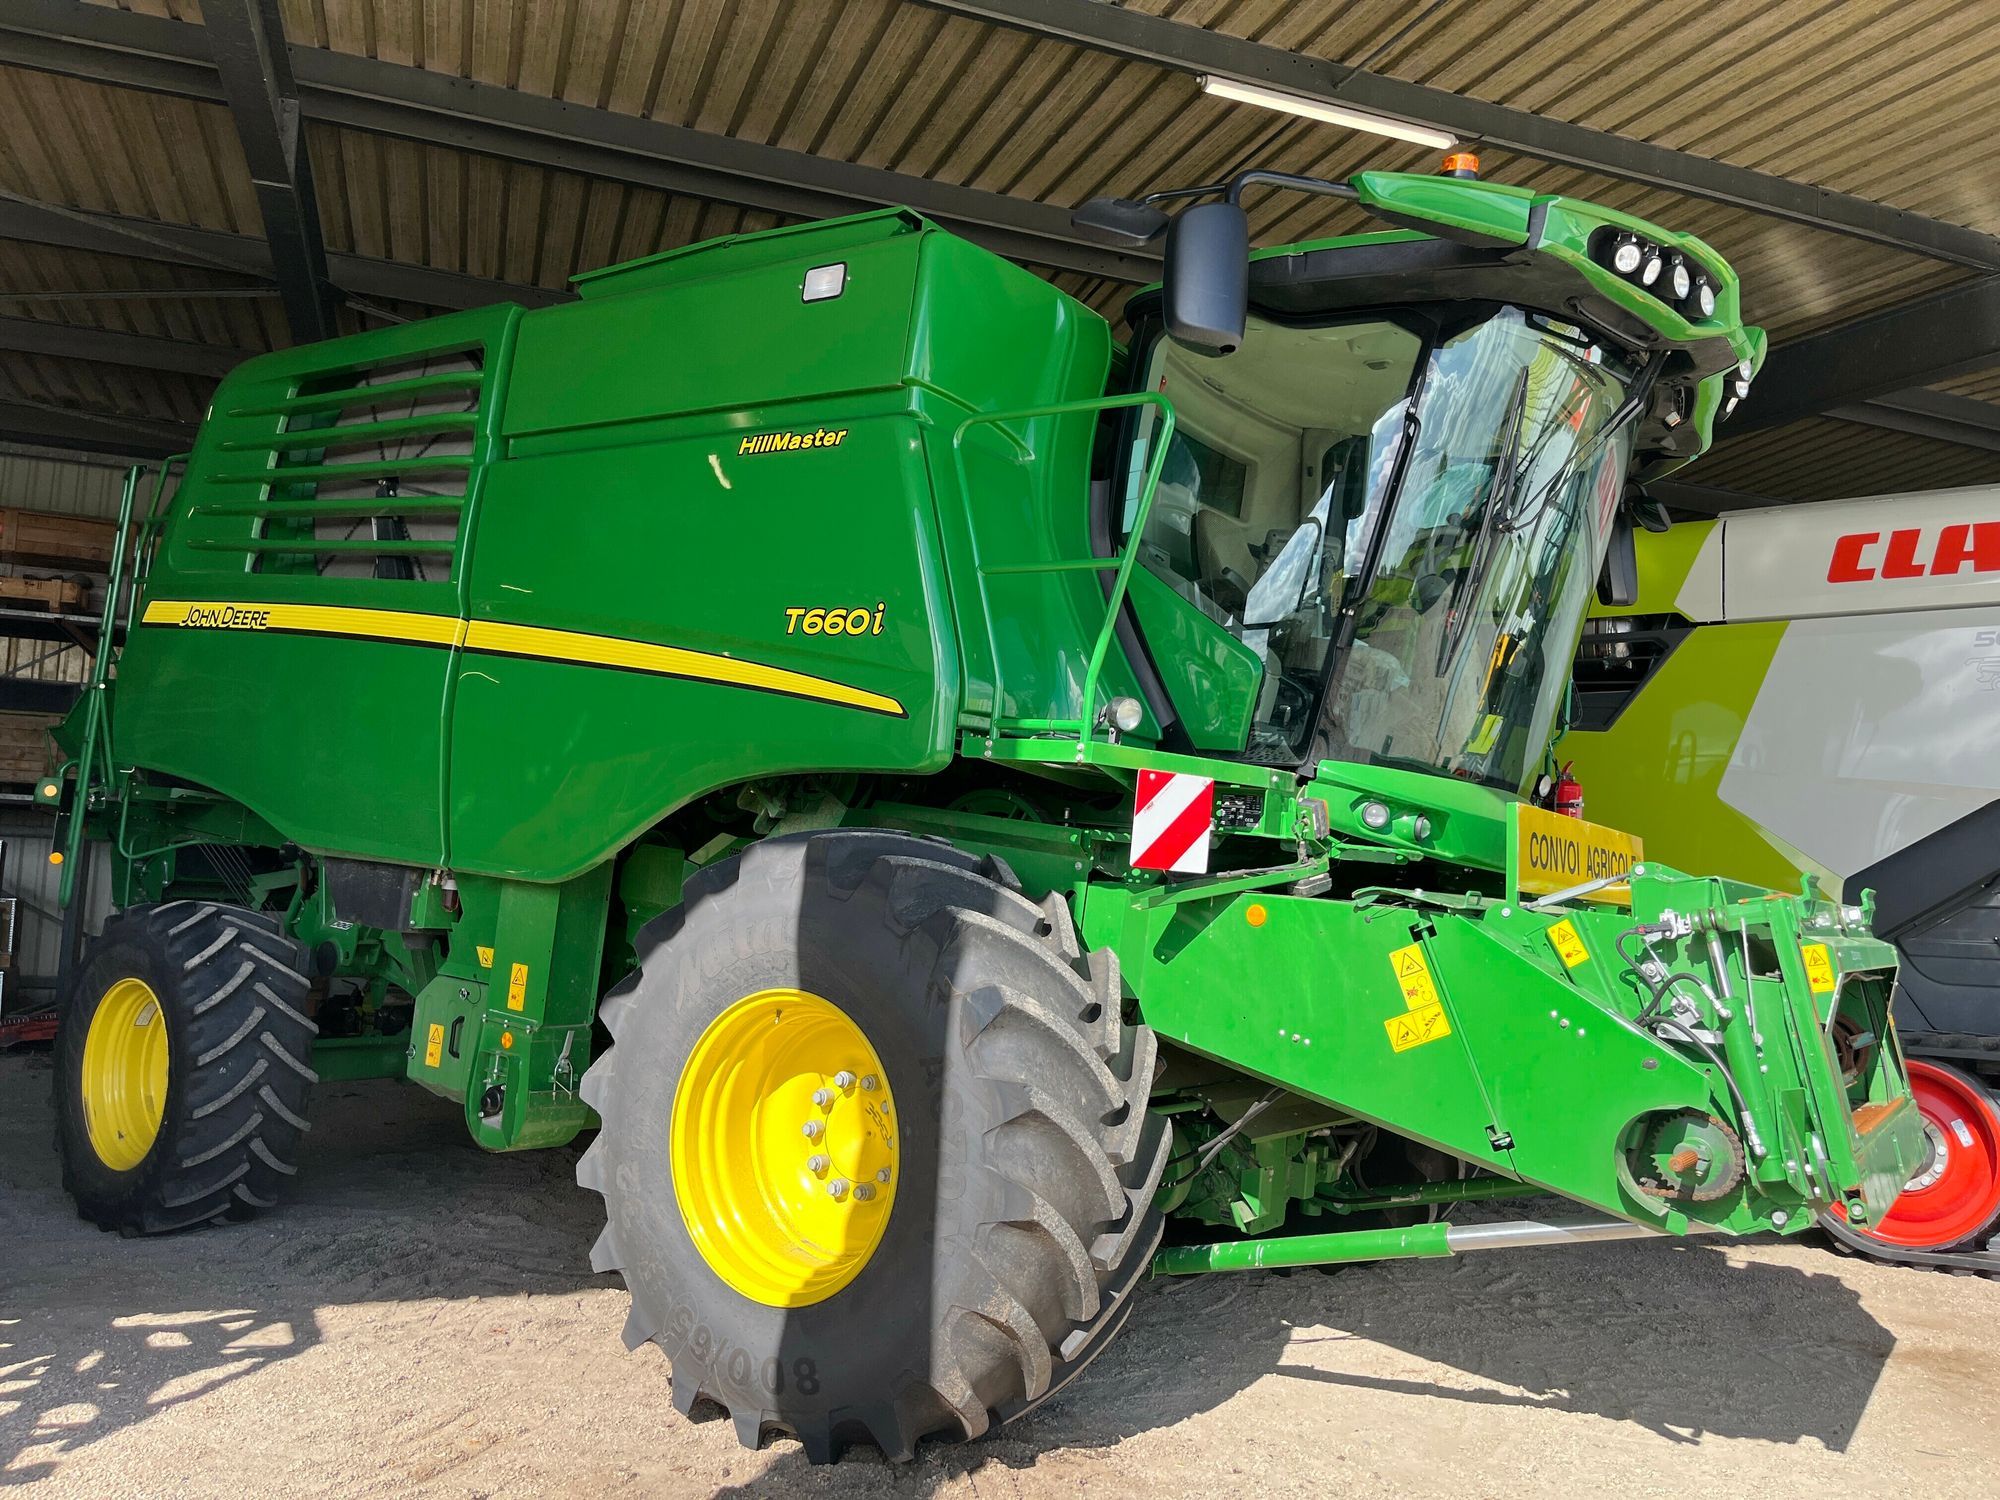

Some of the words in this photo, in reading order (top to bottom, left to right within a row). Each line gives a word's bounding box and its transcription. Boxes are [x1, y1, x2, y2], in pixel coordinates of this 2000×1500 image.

[737, 428, 849, 456] HillMaster
[182, 605, 221, 625] JOHN
[221, 606, 271, 627] DEERE
[785, 602, 886, 638] T660i
[1530, 831, 1580, 877] CONVOI
